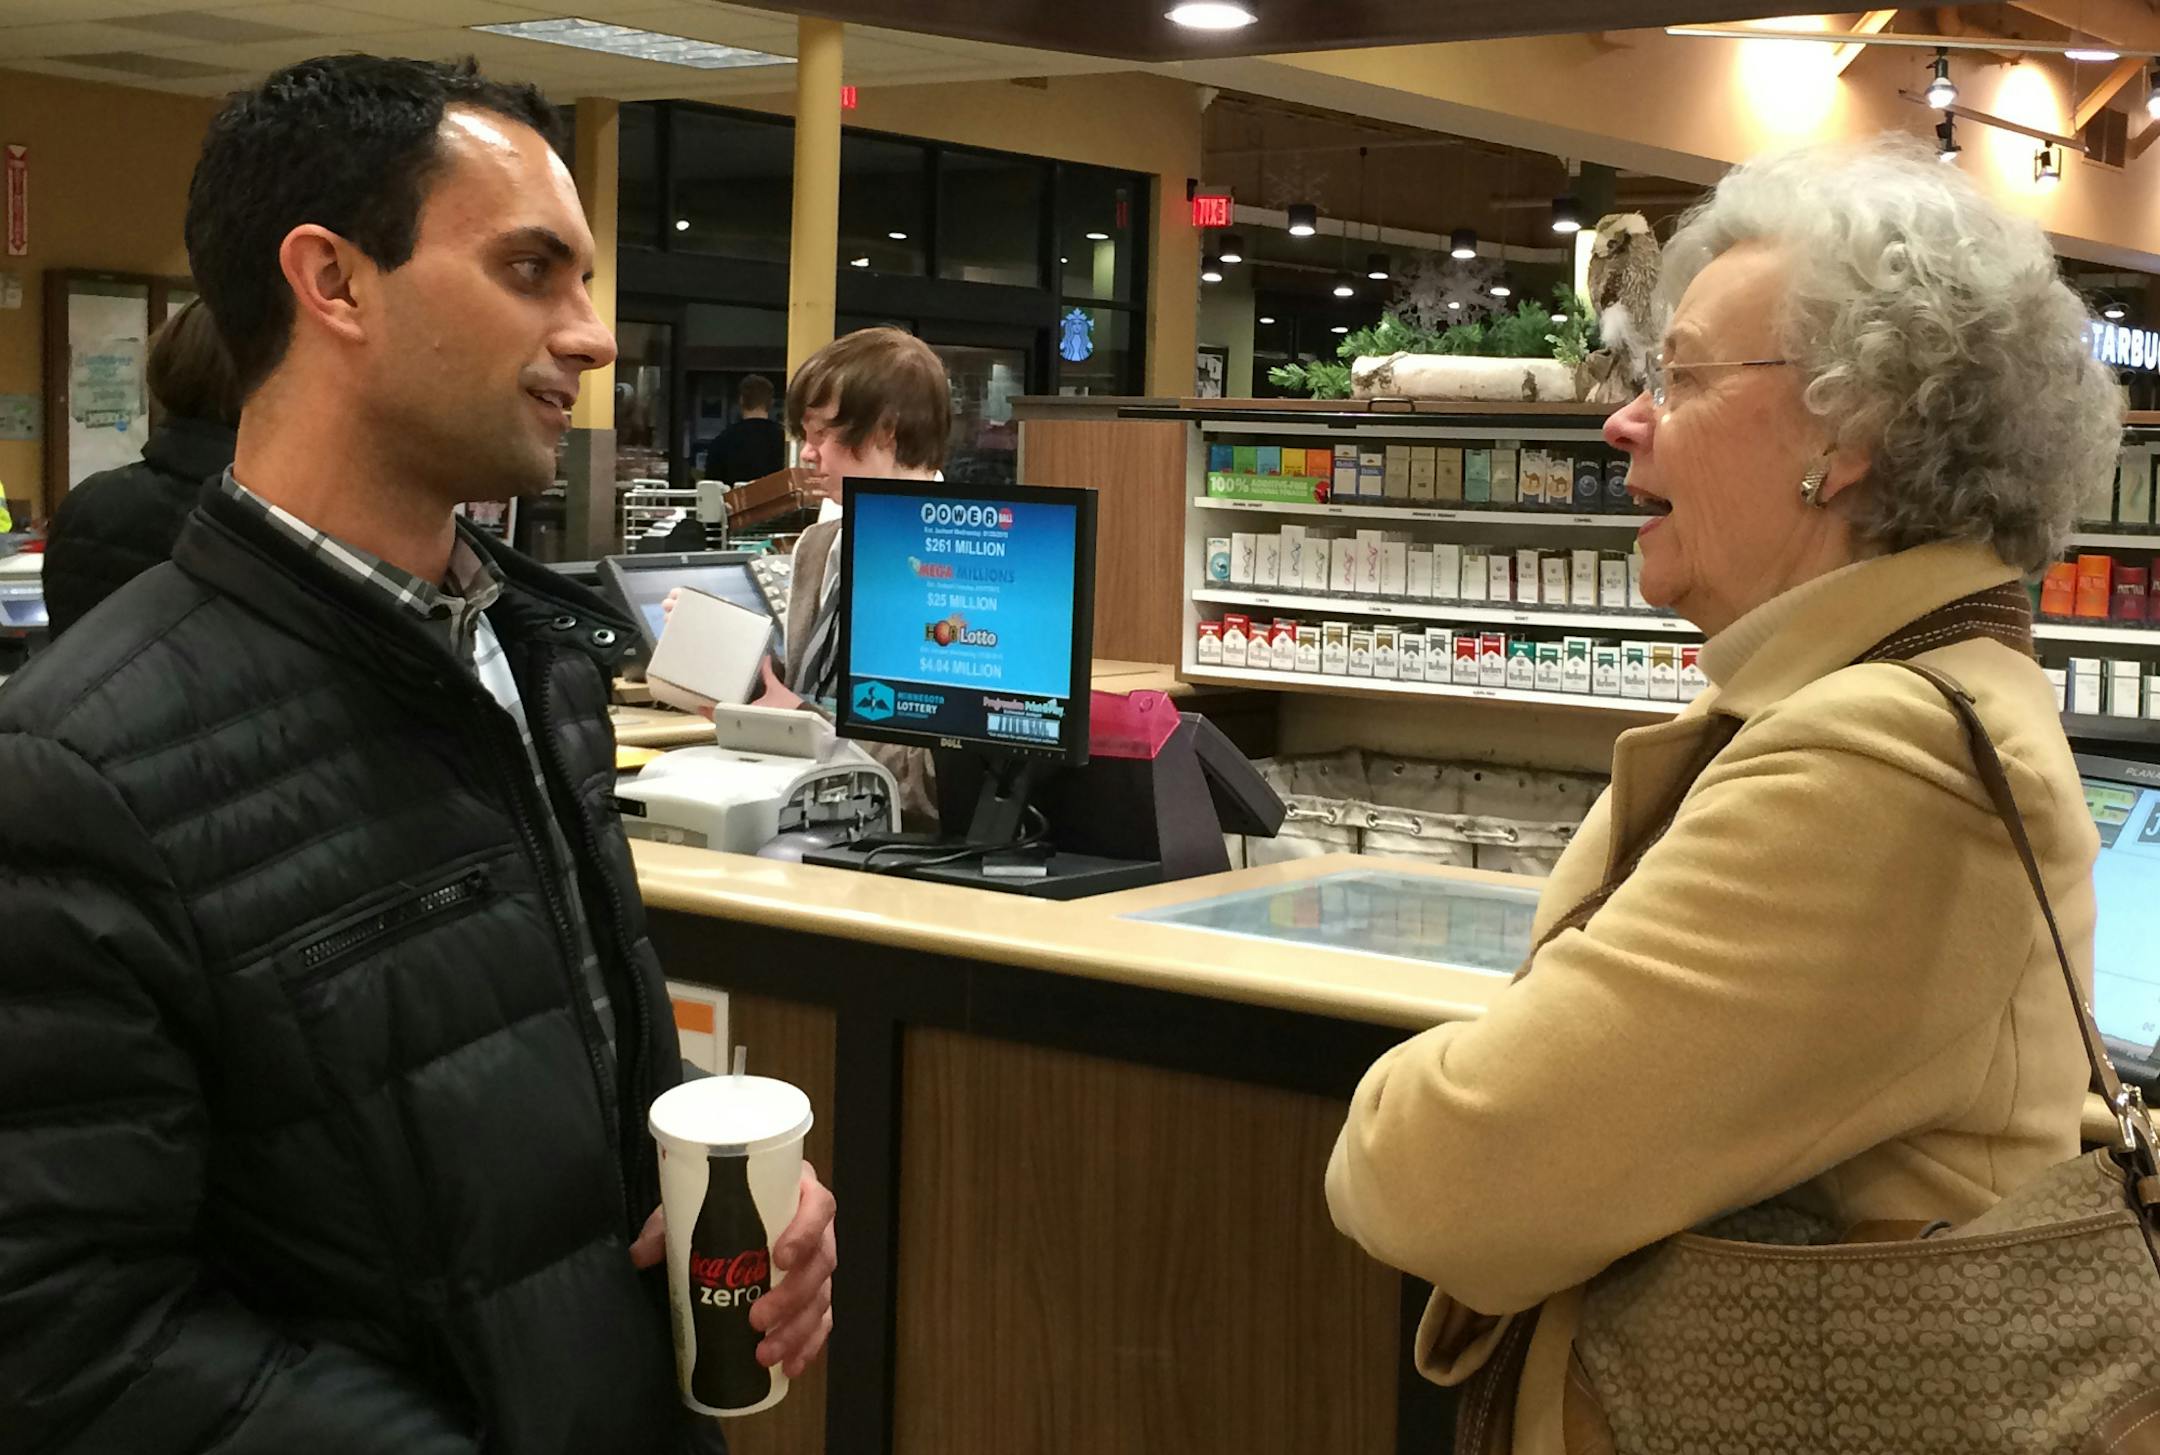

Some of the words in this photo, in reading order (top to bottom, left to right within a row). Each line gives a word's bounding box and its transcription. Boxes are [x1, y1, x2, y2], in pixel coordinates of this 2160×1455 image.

[2081, 322, 2160, 374] TARBU
[1209, 476, 1249, 493] 100%
[921, 502, 998, 528] POWER
[925, 537, 951, 553] $261
[955, 539, 1005, 557] MILLION
[917, 562, 953, 579] MEGA
[956, 566, 1015, 584] MILLIONS
[927, 592, 946, 607] $25
[949, 594, 998, 611] MILLION
[960, 627, 998, 648] Lotto
[951, 659, 1002, 678] MILLION
[897, 701, 938, 715] LOTTERY
[700, 1285, 761, 1307] zero
